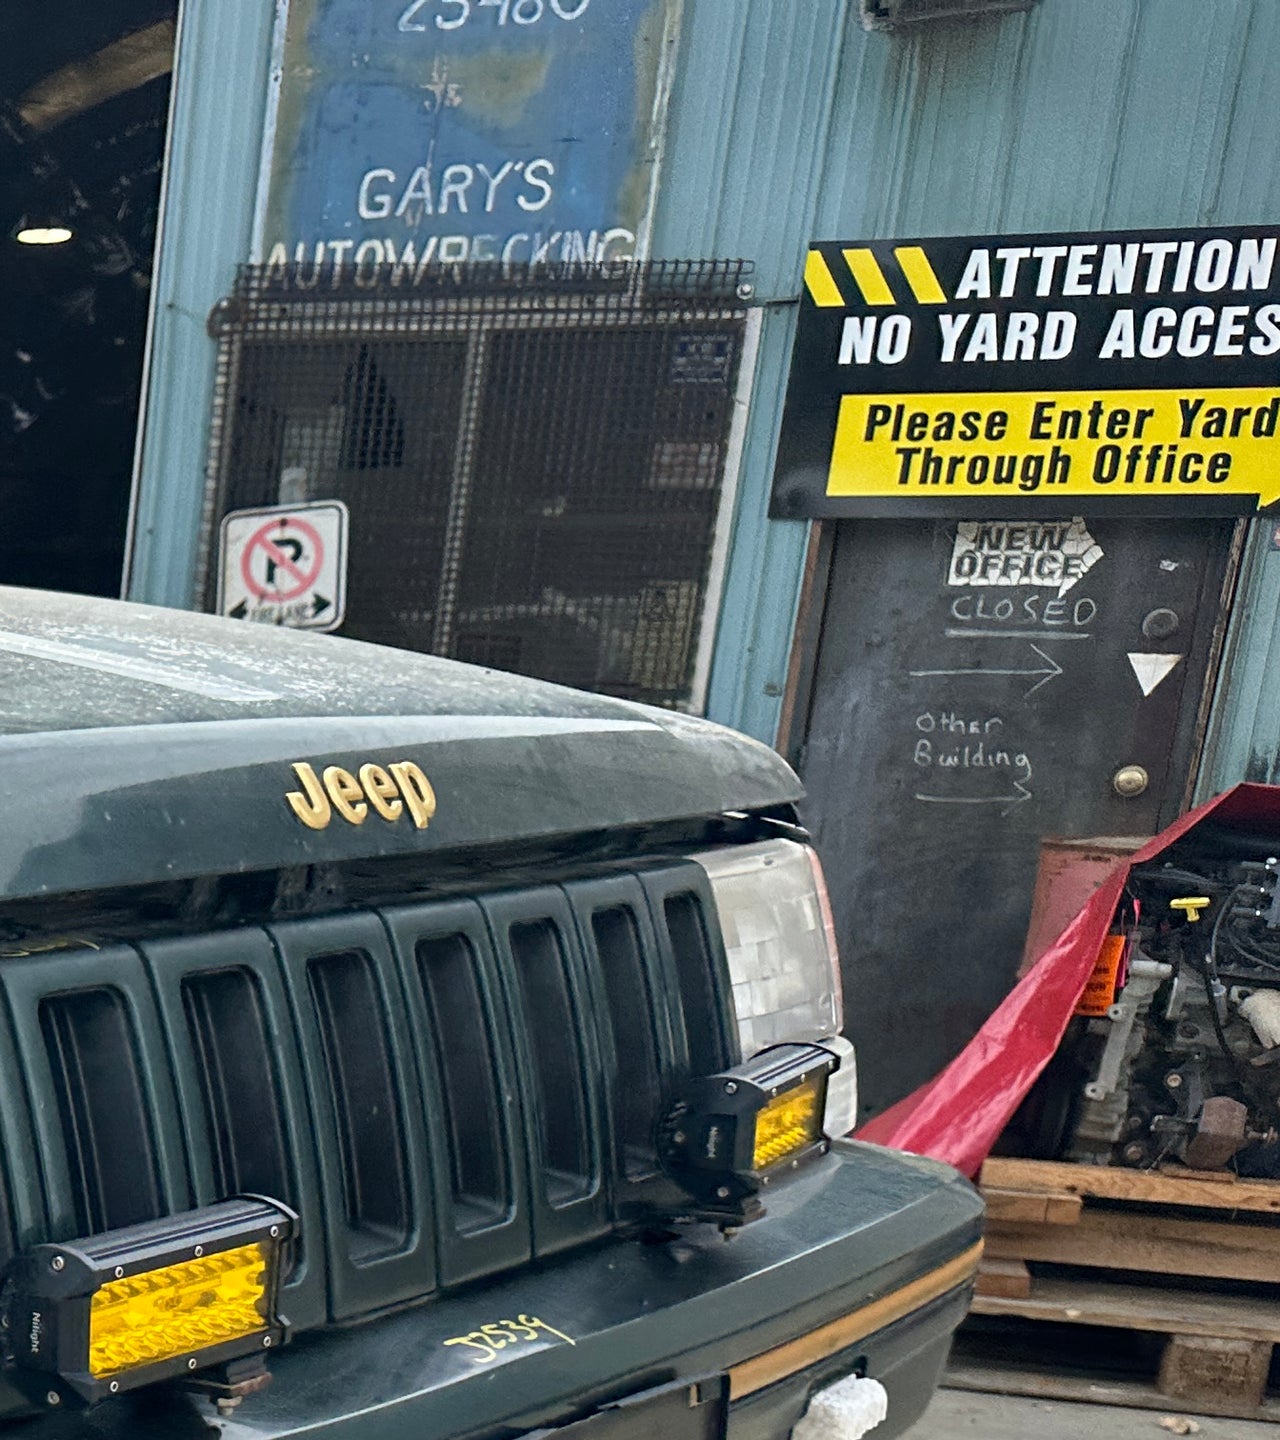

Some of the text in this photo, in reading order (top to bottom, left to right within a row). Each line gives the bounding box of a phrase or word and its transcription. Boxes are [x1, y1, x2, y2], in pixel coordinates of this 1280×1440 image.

[358, 158, 555, 220] GARY'S
[261, 227, 637, 291] AUTOWRECKING
[955, 238, 1277, 300] ATTENTION
[838, 315, 912, 365] NO
[940, 310, 1077, 363] YARD
[864, 396, 1280, 442] Please Enter Yard
[895, 444, 1233, 492] Through Office
[976, 524, 1069, 551] NEW
[954, 550, 1084, 579] OFFICE
[951, 594, 1097, 626] CLOSED
[915, 711, 1003, 736] Other
[914, 738, 1032, 783] Building
[285, 760, 437, 830] Jeep
[442, 1314, 577, 1364] J2539
